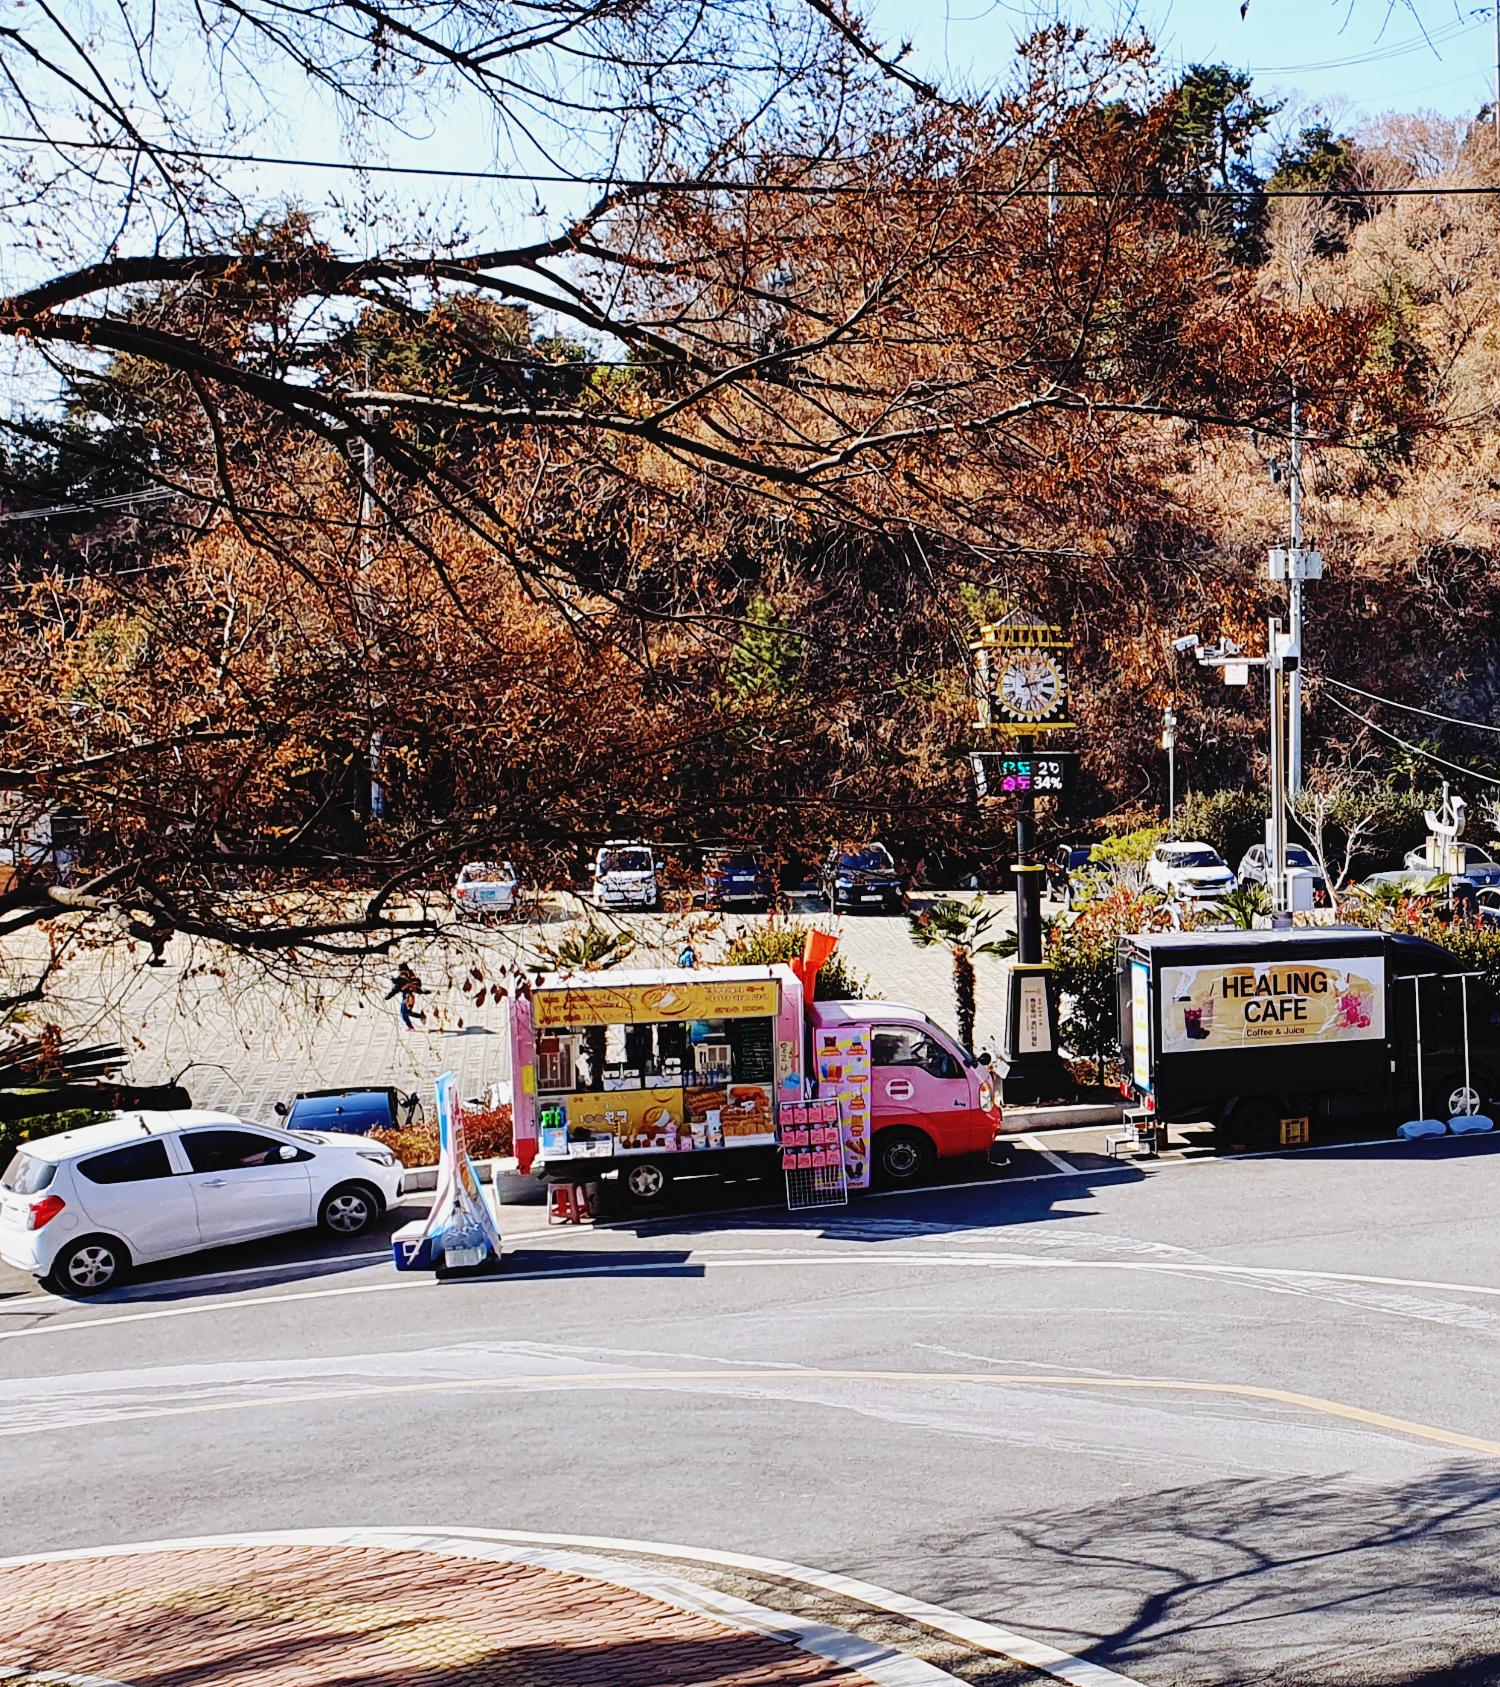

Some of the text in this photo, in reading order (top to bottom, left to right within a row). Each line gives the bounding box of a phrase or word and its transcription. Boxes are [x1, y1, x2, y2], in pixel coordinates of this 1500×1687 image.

[1033, 776, 1063, 790] 34%
[1222, 971, 1328, 998] HEALING
[1244, 998, 1307, 1023] CAFE
[1246, 1027, 1273, 1037] Coffee
[1283, 1026, 1305, 1035] Juice
